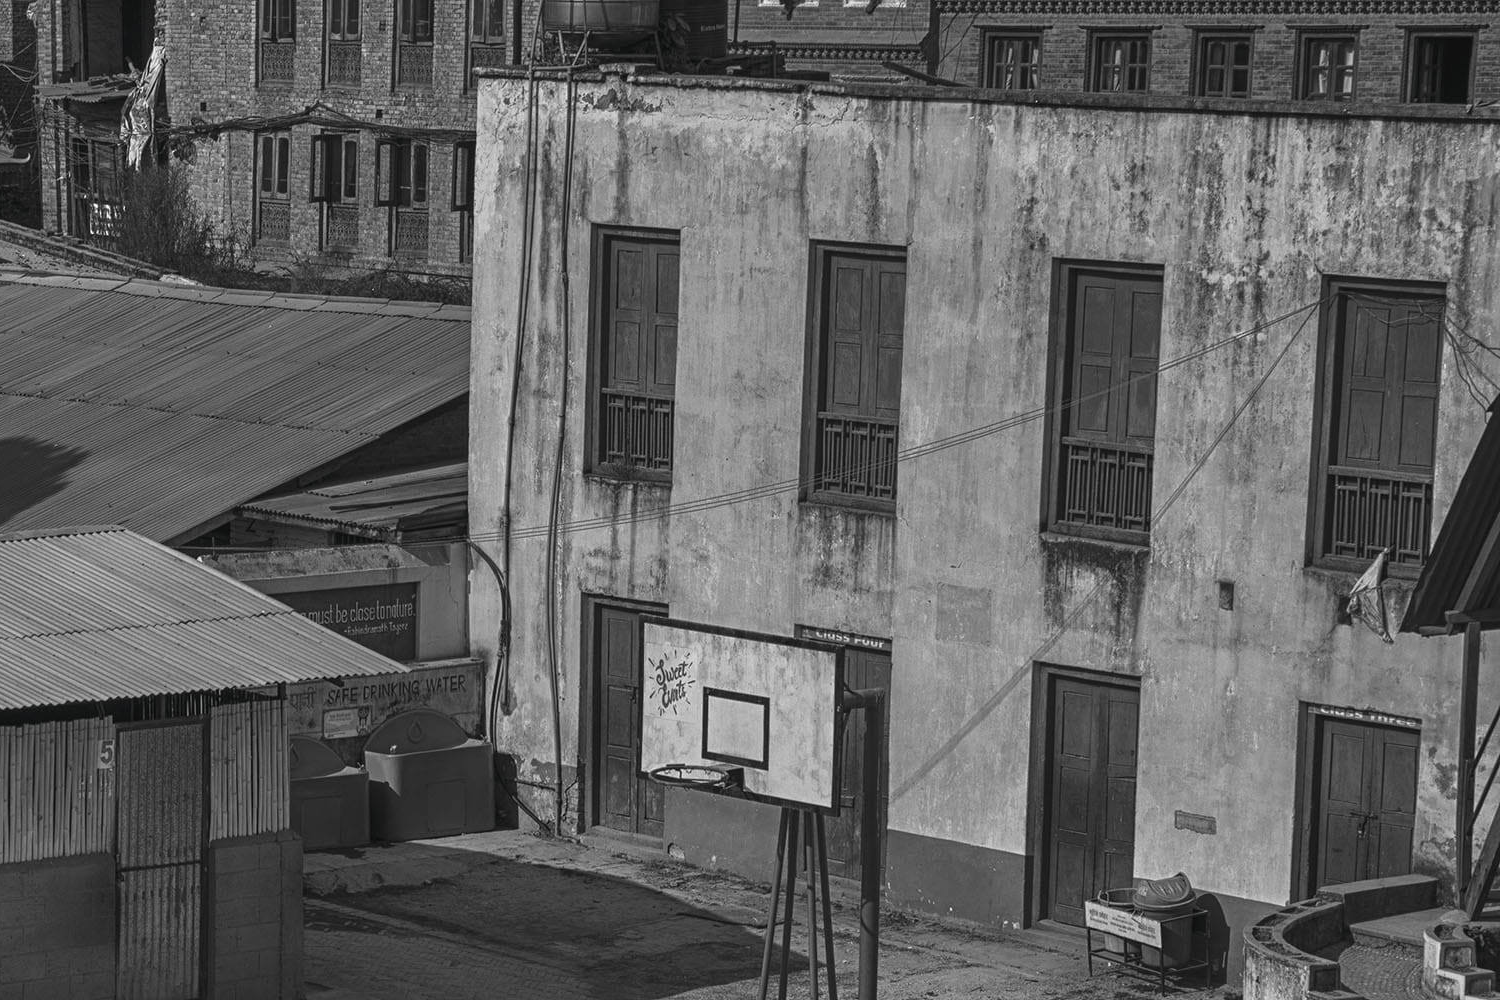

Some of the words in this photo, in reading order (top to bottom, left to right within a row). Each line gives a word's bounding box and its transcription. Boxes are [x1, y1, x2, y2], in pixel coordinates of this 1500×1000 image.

[335, 602, 348, 624] be
[349, 601, 376, 623] close
[376, 599, 385, 620] to
[655, 659, 688, 686] Sweet
[327, 686, 358, 705] SAFE
[363, 679, 420, 700] DRINKING
[426, 674, 467, 694] WATER
[100, 740, 113, 764] 5
